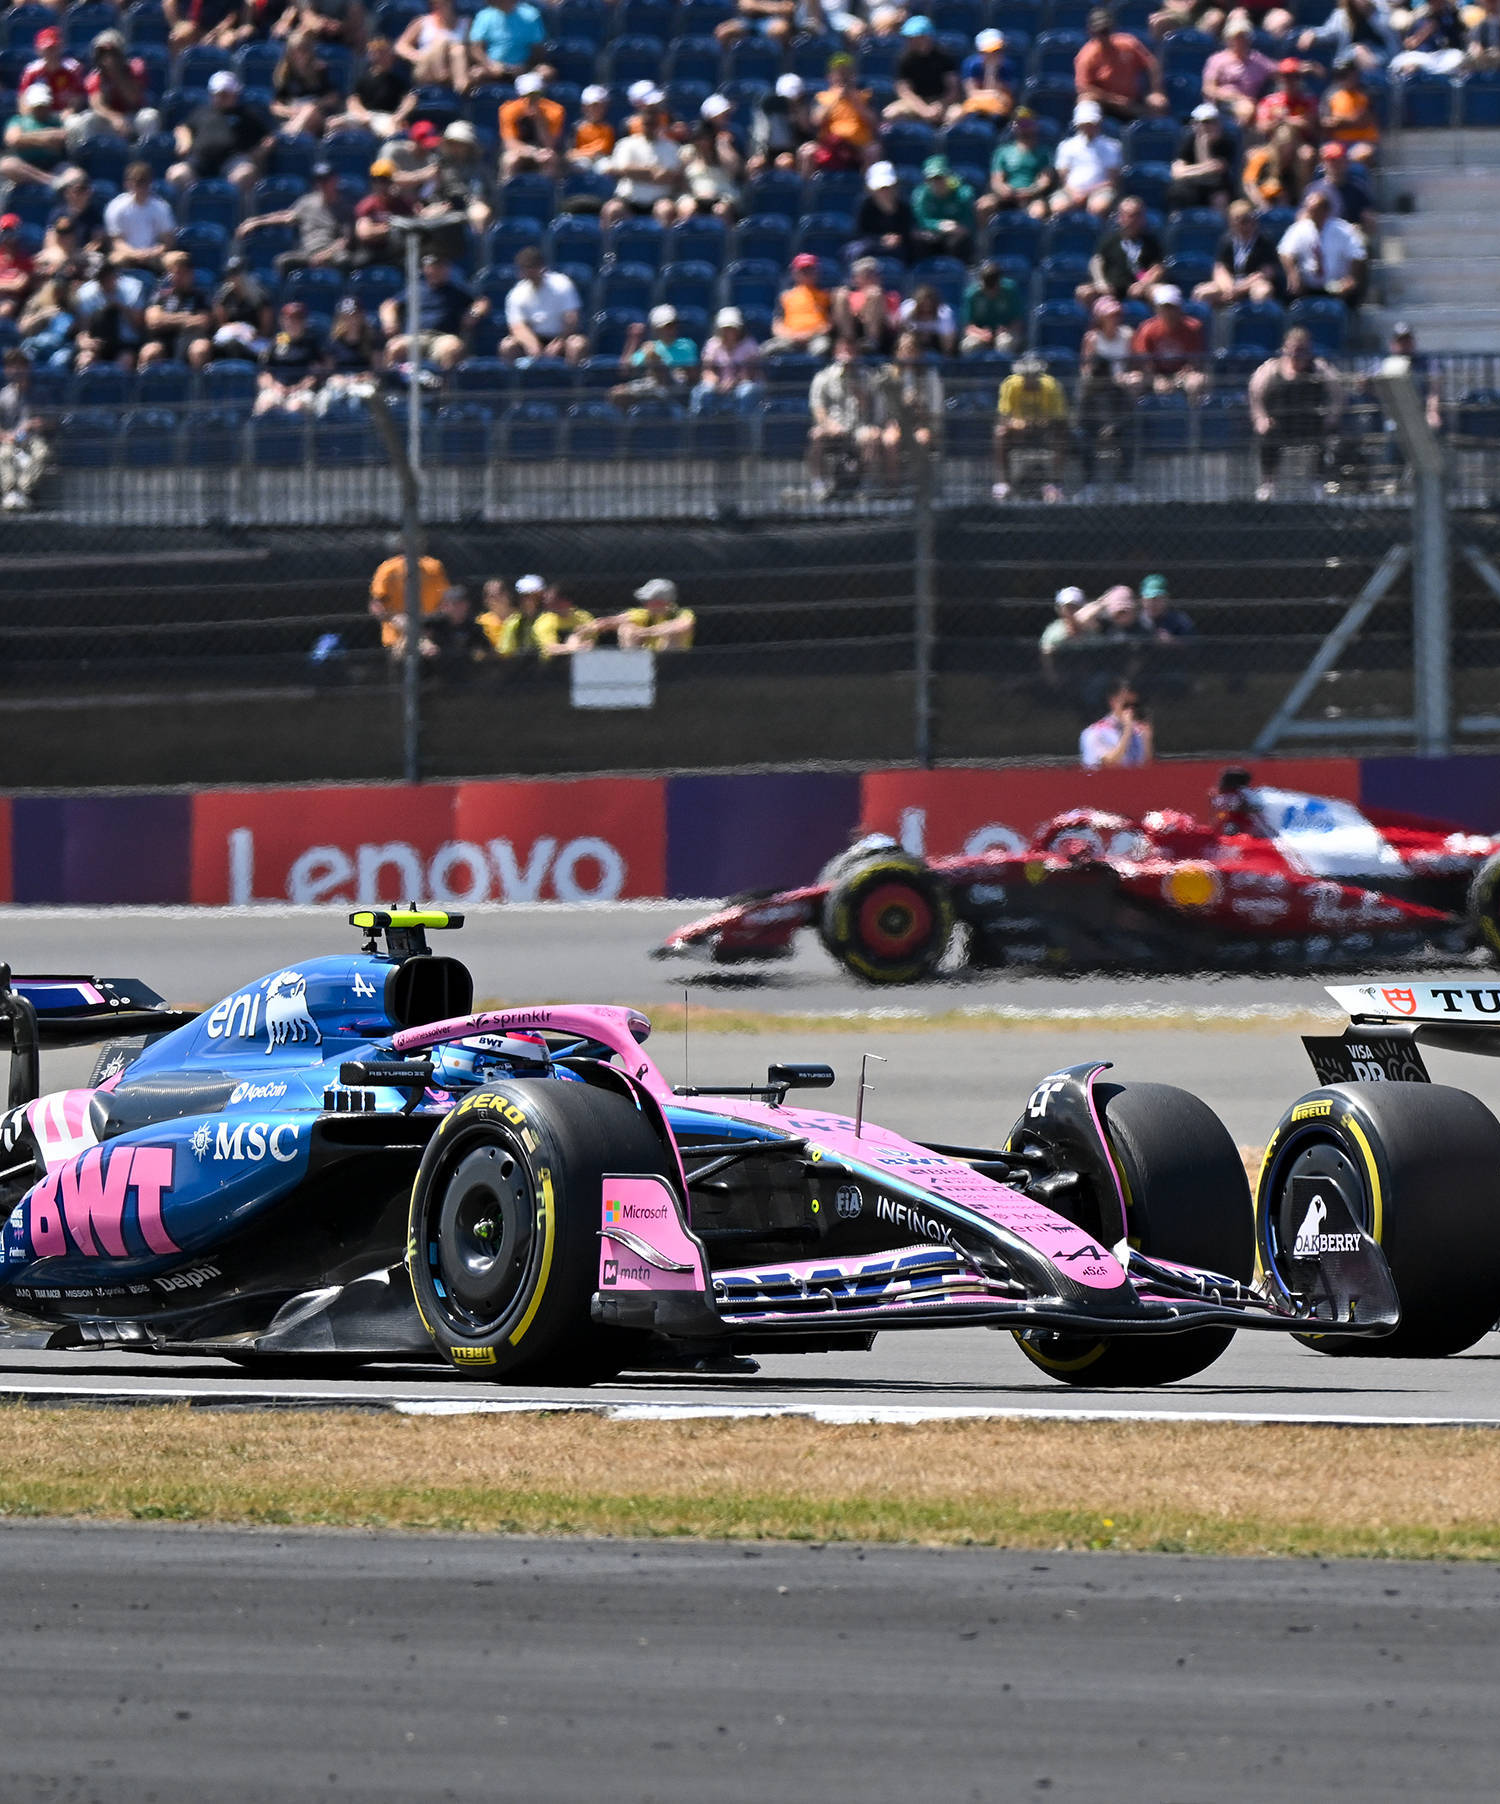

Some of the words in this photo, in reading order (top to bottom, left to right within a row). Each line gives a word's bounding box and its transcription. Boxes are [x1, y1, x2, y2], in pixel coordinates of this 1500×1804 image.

[227, 827, 627, 901] Lenovo
[207, 992, 261, 1039] eni
[492, 1010, 553, 1030] sprinklr
[478, 1036, 504, 1048] BWT
[1344, 1044, 1375, 1060] VISA
[243, 1081, 288, 1102] ApeCoin
[457, 1093, 527, 1125] ZERO
[1291, 1099, 1334, 1121] PIRELLI
[213, 1122, 300, 1162] MSC
[30, 1147, 183, 1257] BWT
[622, 1204, 668, 1219] Microsoft
[876, 1195, 953, 1246] INFINOX
[1295, 1233, 1361, 1252] OAKBERRY
[153, 1263, 223, 1293] Delphi
[620, 1266, 650, 1280] mntn
[65, 1290, 94, 1298] MISSION
[450, 1346, 497, 1366] PIRELLI
